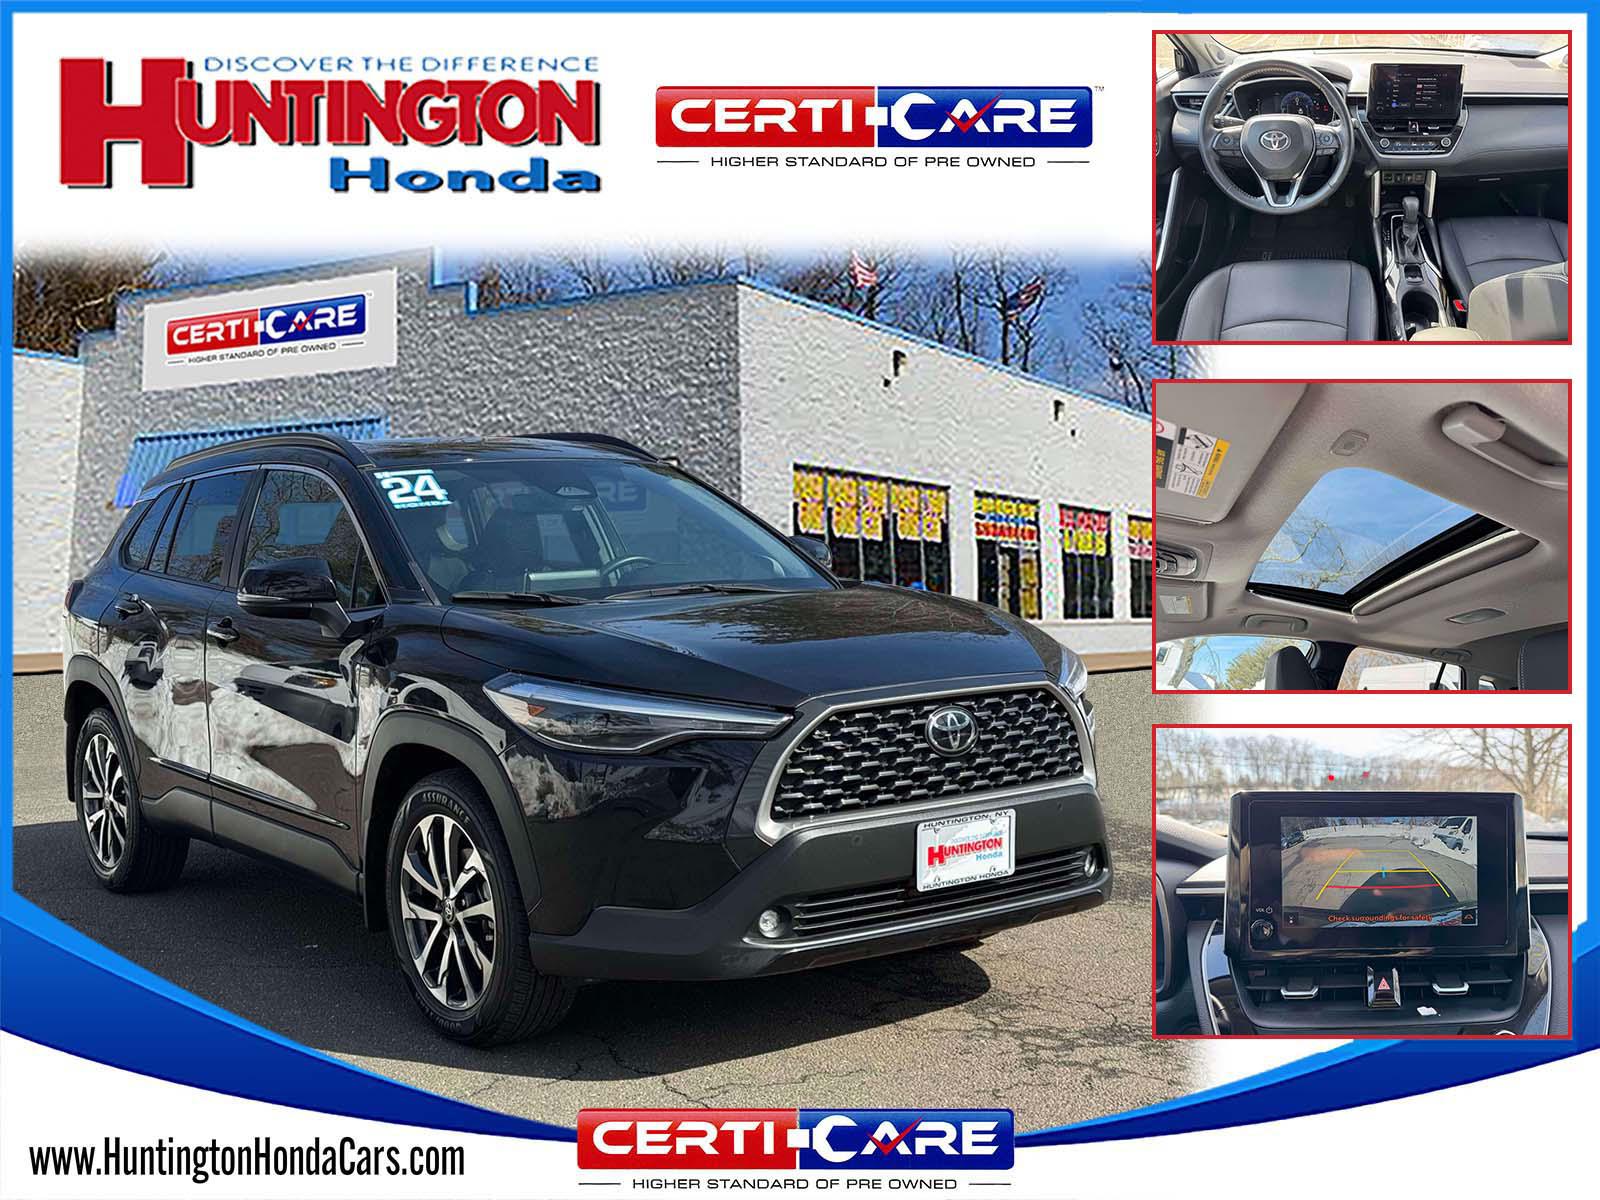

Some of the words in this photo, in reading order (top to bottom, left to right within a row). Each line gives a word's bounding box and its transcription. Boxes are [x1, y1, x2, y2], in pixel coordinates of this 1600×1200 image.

[188, 354, 218, 364] HIGHER
[219, 349, 265, 361] STANDARD
[267, 347, 279, 356] OF
[281, 345, 299, 355] PRE
[301, 342, 336, 353] OWNED
[381, 474, 449, 504] 24
[422, 791, 470, 824] ASSURANCE
[995, 810, 1009, 818] NY
[927, 837, 1003, 867] HUNTINGTON
[976, 851, 1003, 861] Honda
[922, 875, 978, 890] HUNTINGTON
[979, 869, 1009, 880] HONDA
[1327, 914, 1349, 922] Check
[1351, 913, 1398, 924] surroundings
[1411, 913, 1433, 923] safety
